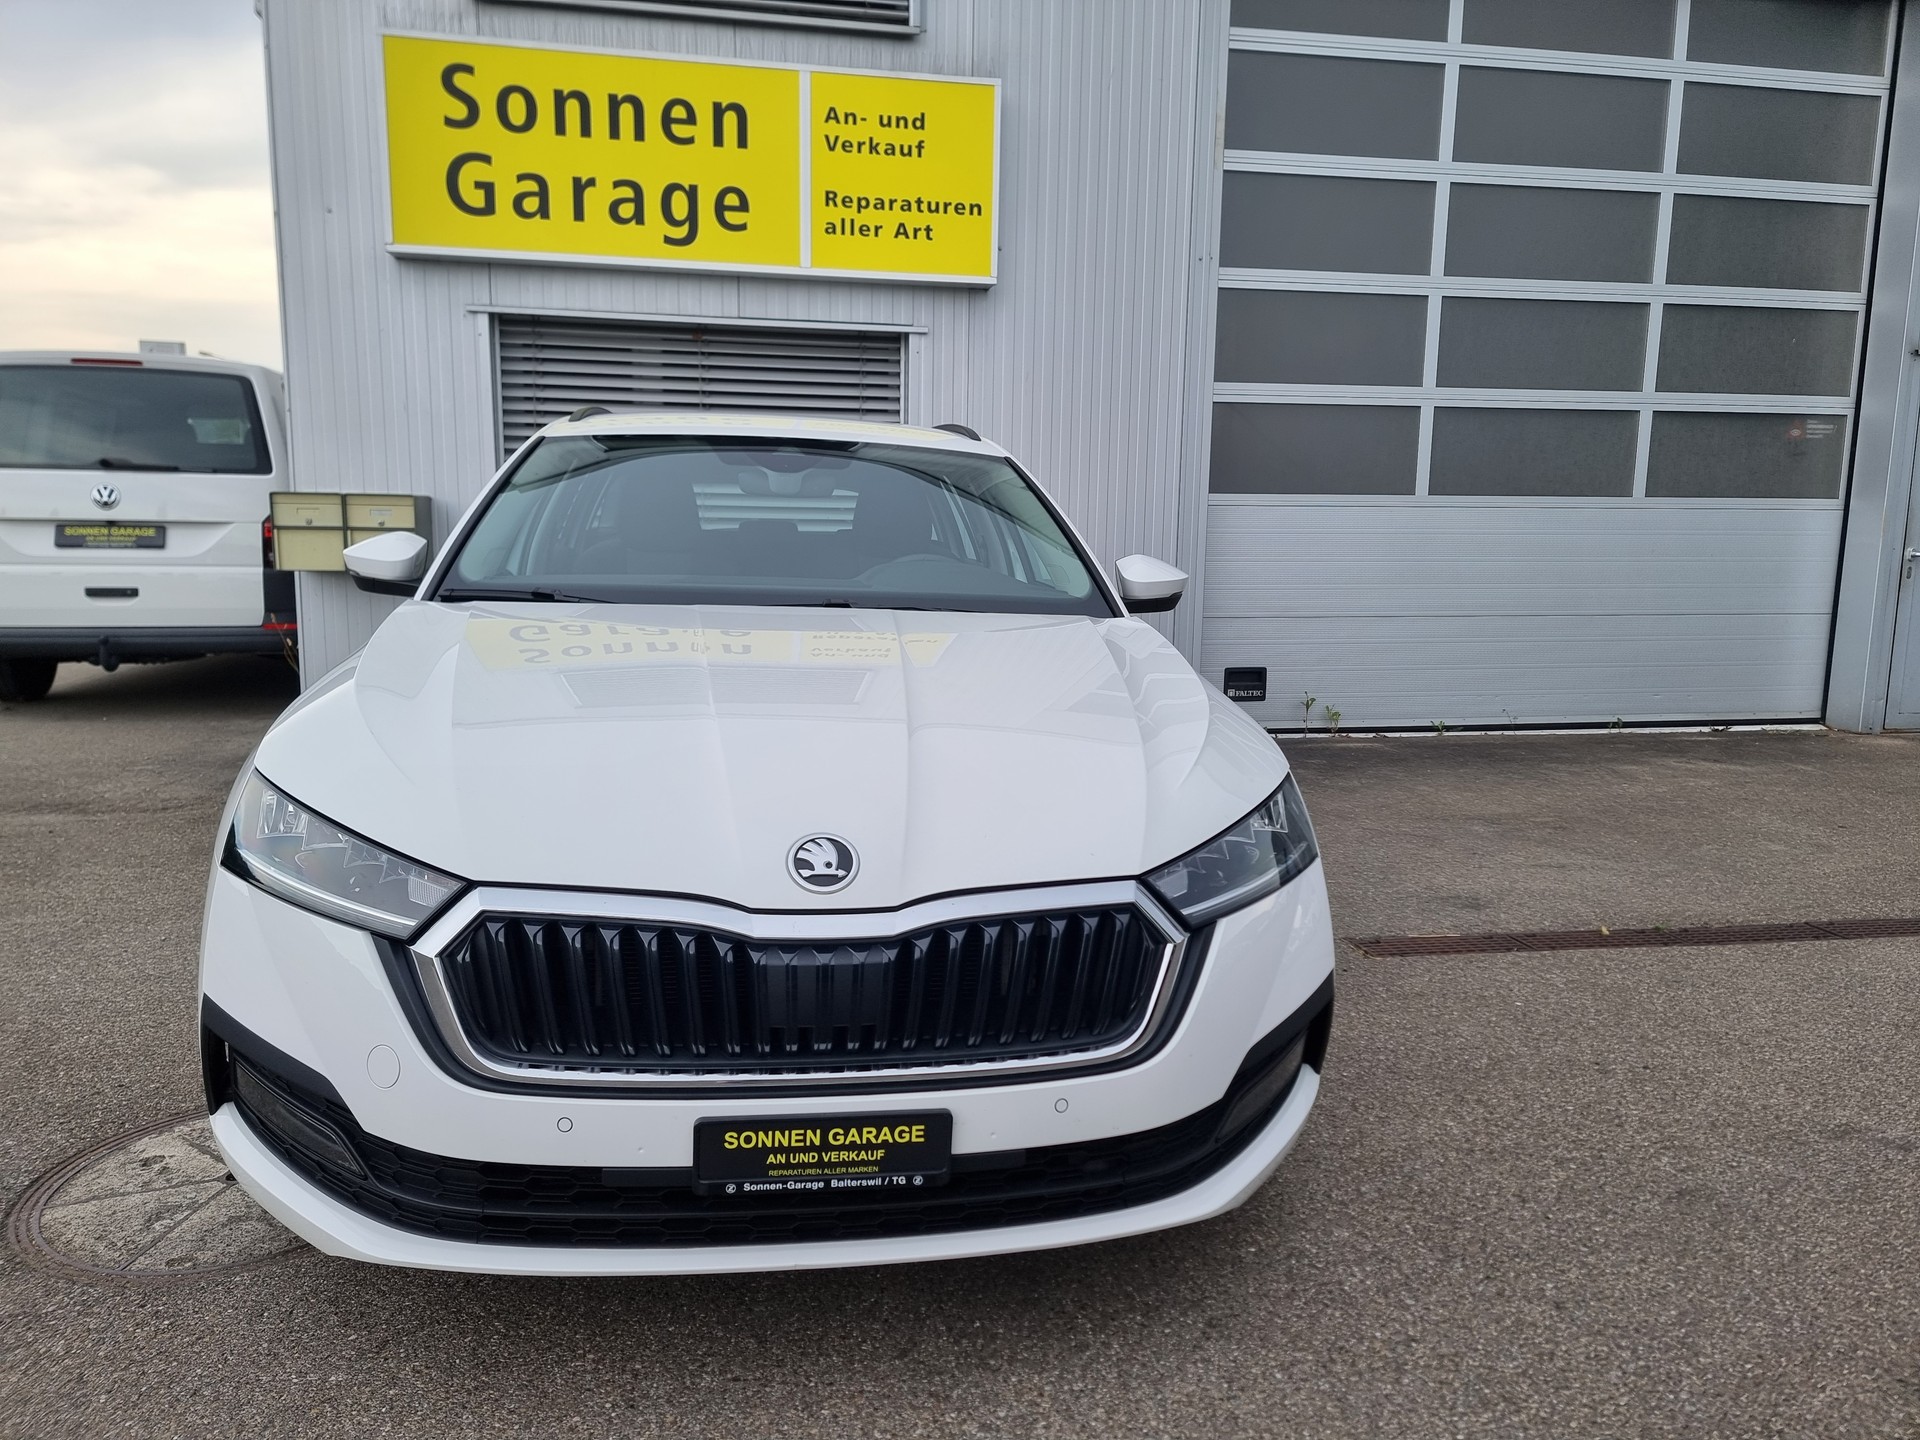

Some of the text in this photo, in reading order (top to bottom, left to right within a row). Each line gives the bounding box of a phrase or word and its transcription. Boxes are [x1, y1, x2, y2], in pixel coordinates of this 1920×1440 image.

[440, 62, 749, 149] Sonnen
[824, 106, 926, 131] An- und
[824, 134, 925, 158] Verkauf
[445, 152, 750, 247] Garage
[825, 190, 983, 217] Reparaturen
[824, 217, 934, 241] aller Art
[64, 526, 156, 537] SONNEN GARAGE
[723, 1125, 925, 1150] SONNEN GARAGE
[766, 1149, 885, 1165] AN UND VERKAUF
[768, 1165, 879, 1177] REPARATUREN ALLER MARKEN
[743, 1175, 907, 1192] Sonnen-Garage Balterswil / TG
